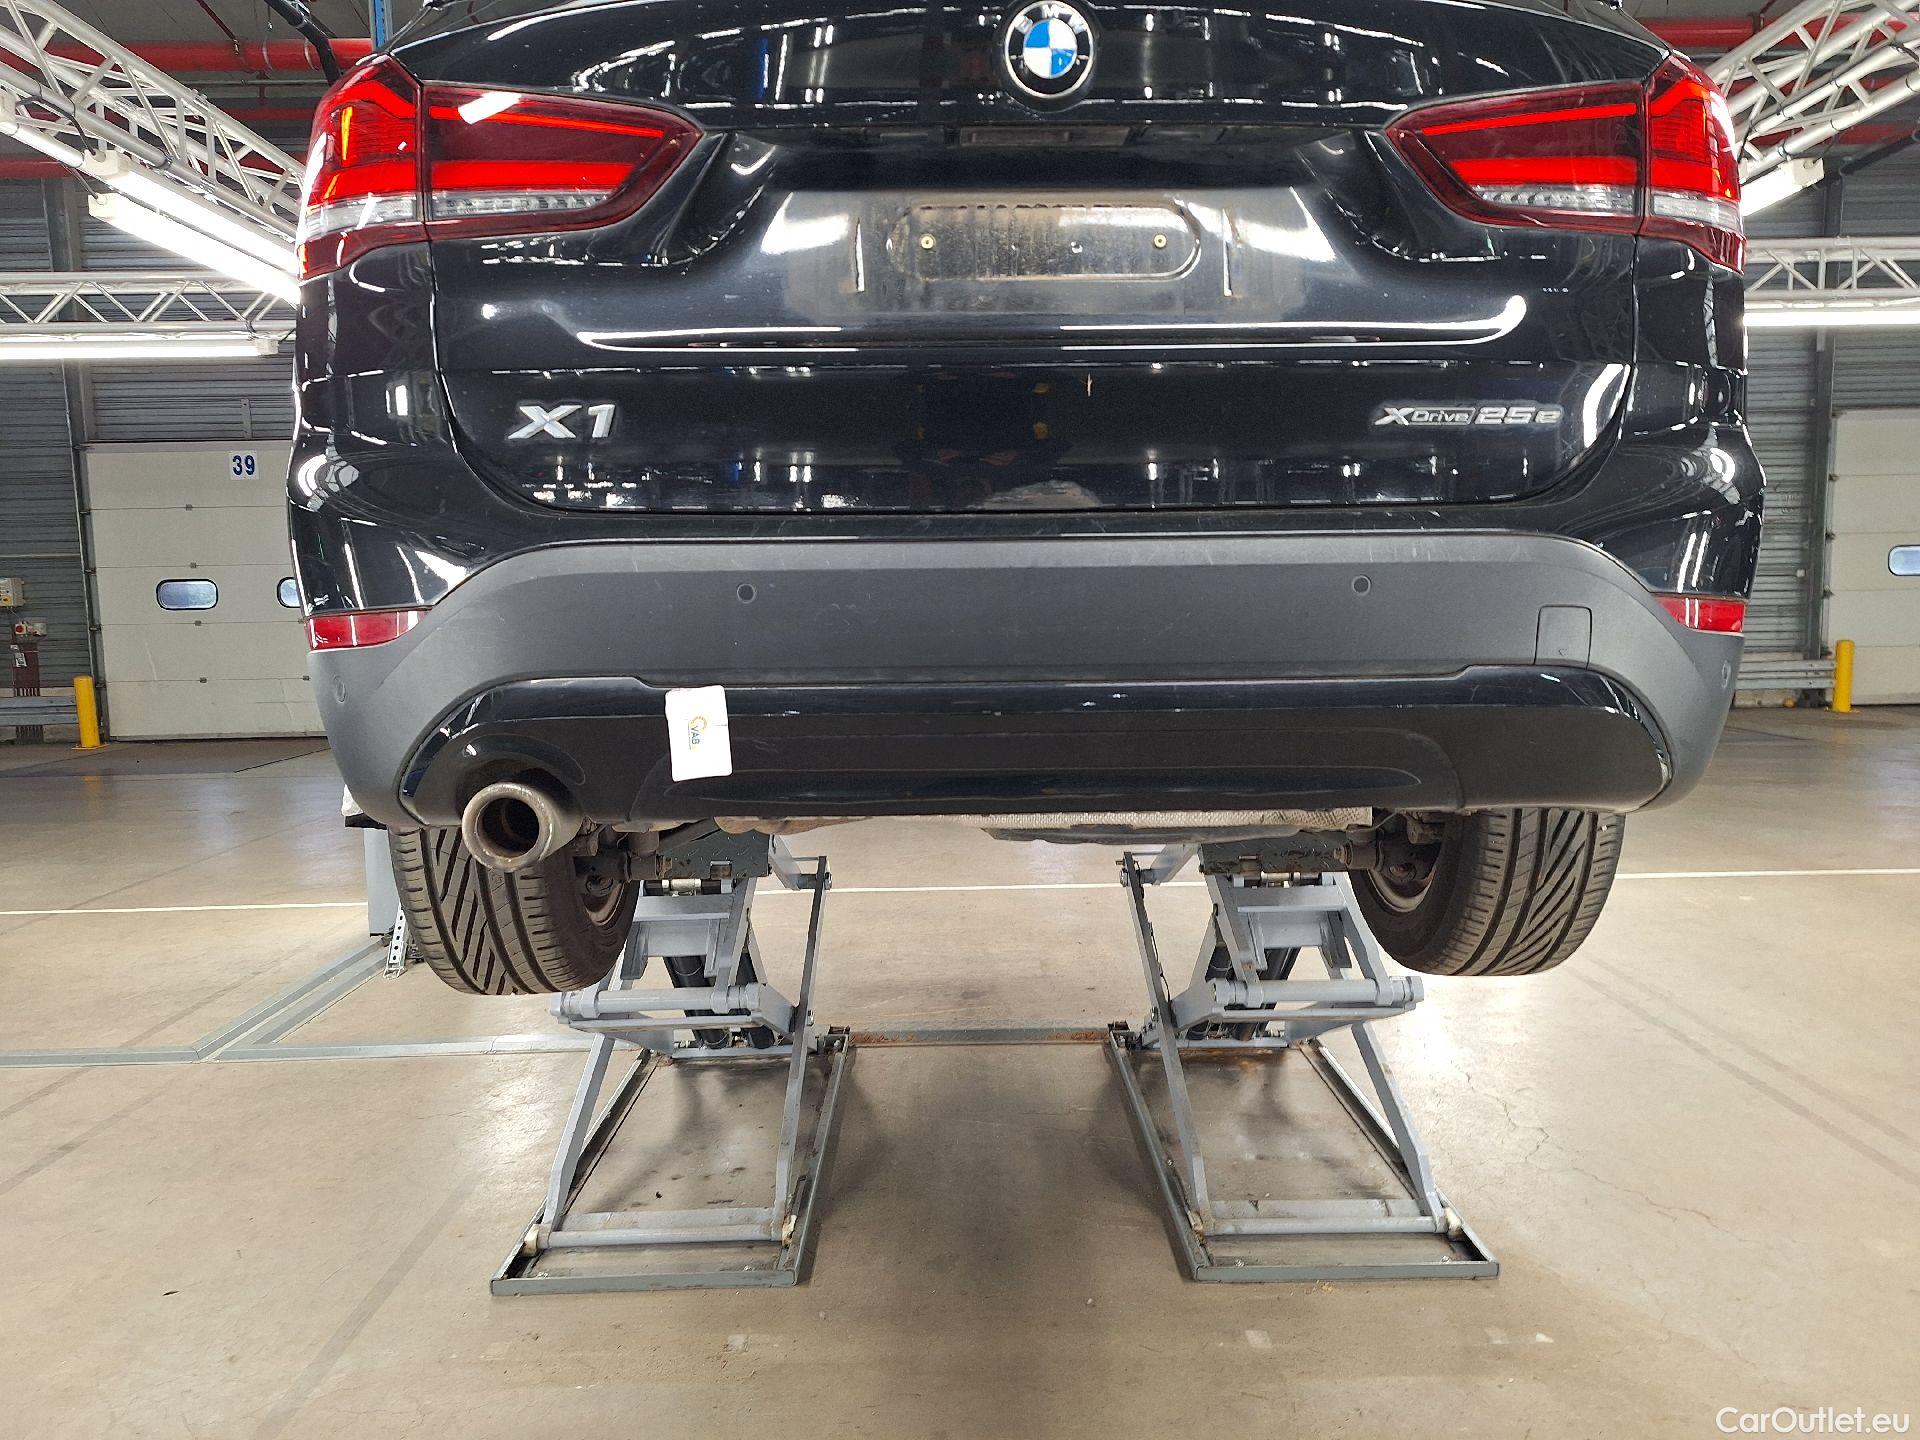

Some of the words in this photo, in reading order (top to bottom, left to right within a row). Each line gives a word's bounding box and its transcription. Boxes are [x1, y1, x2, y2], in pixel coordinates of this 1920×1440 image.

[1014, 4, 1087, 34] BMW
[508, 404, 615, 439] X1
[232, 455, 255, 476] 39
